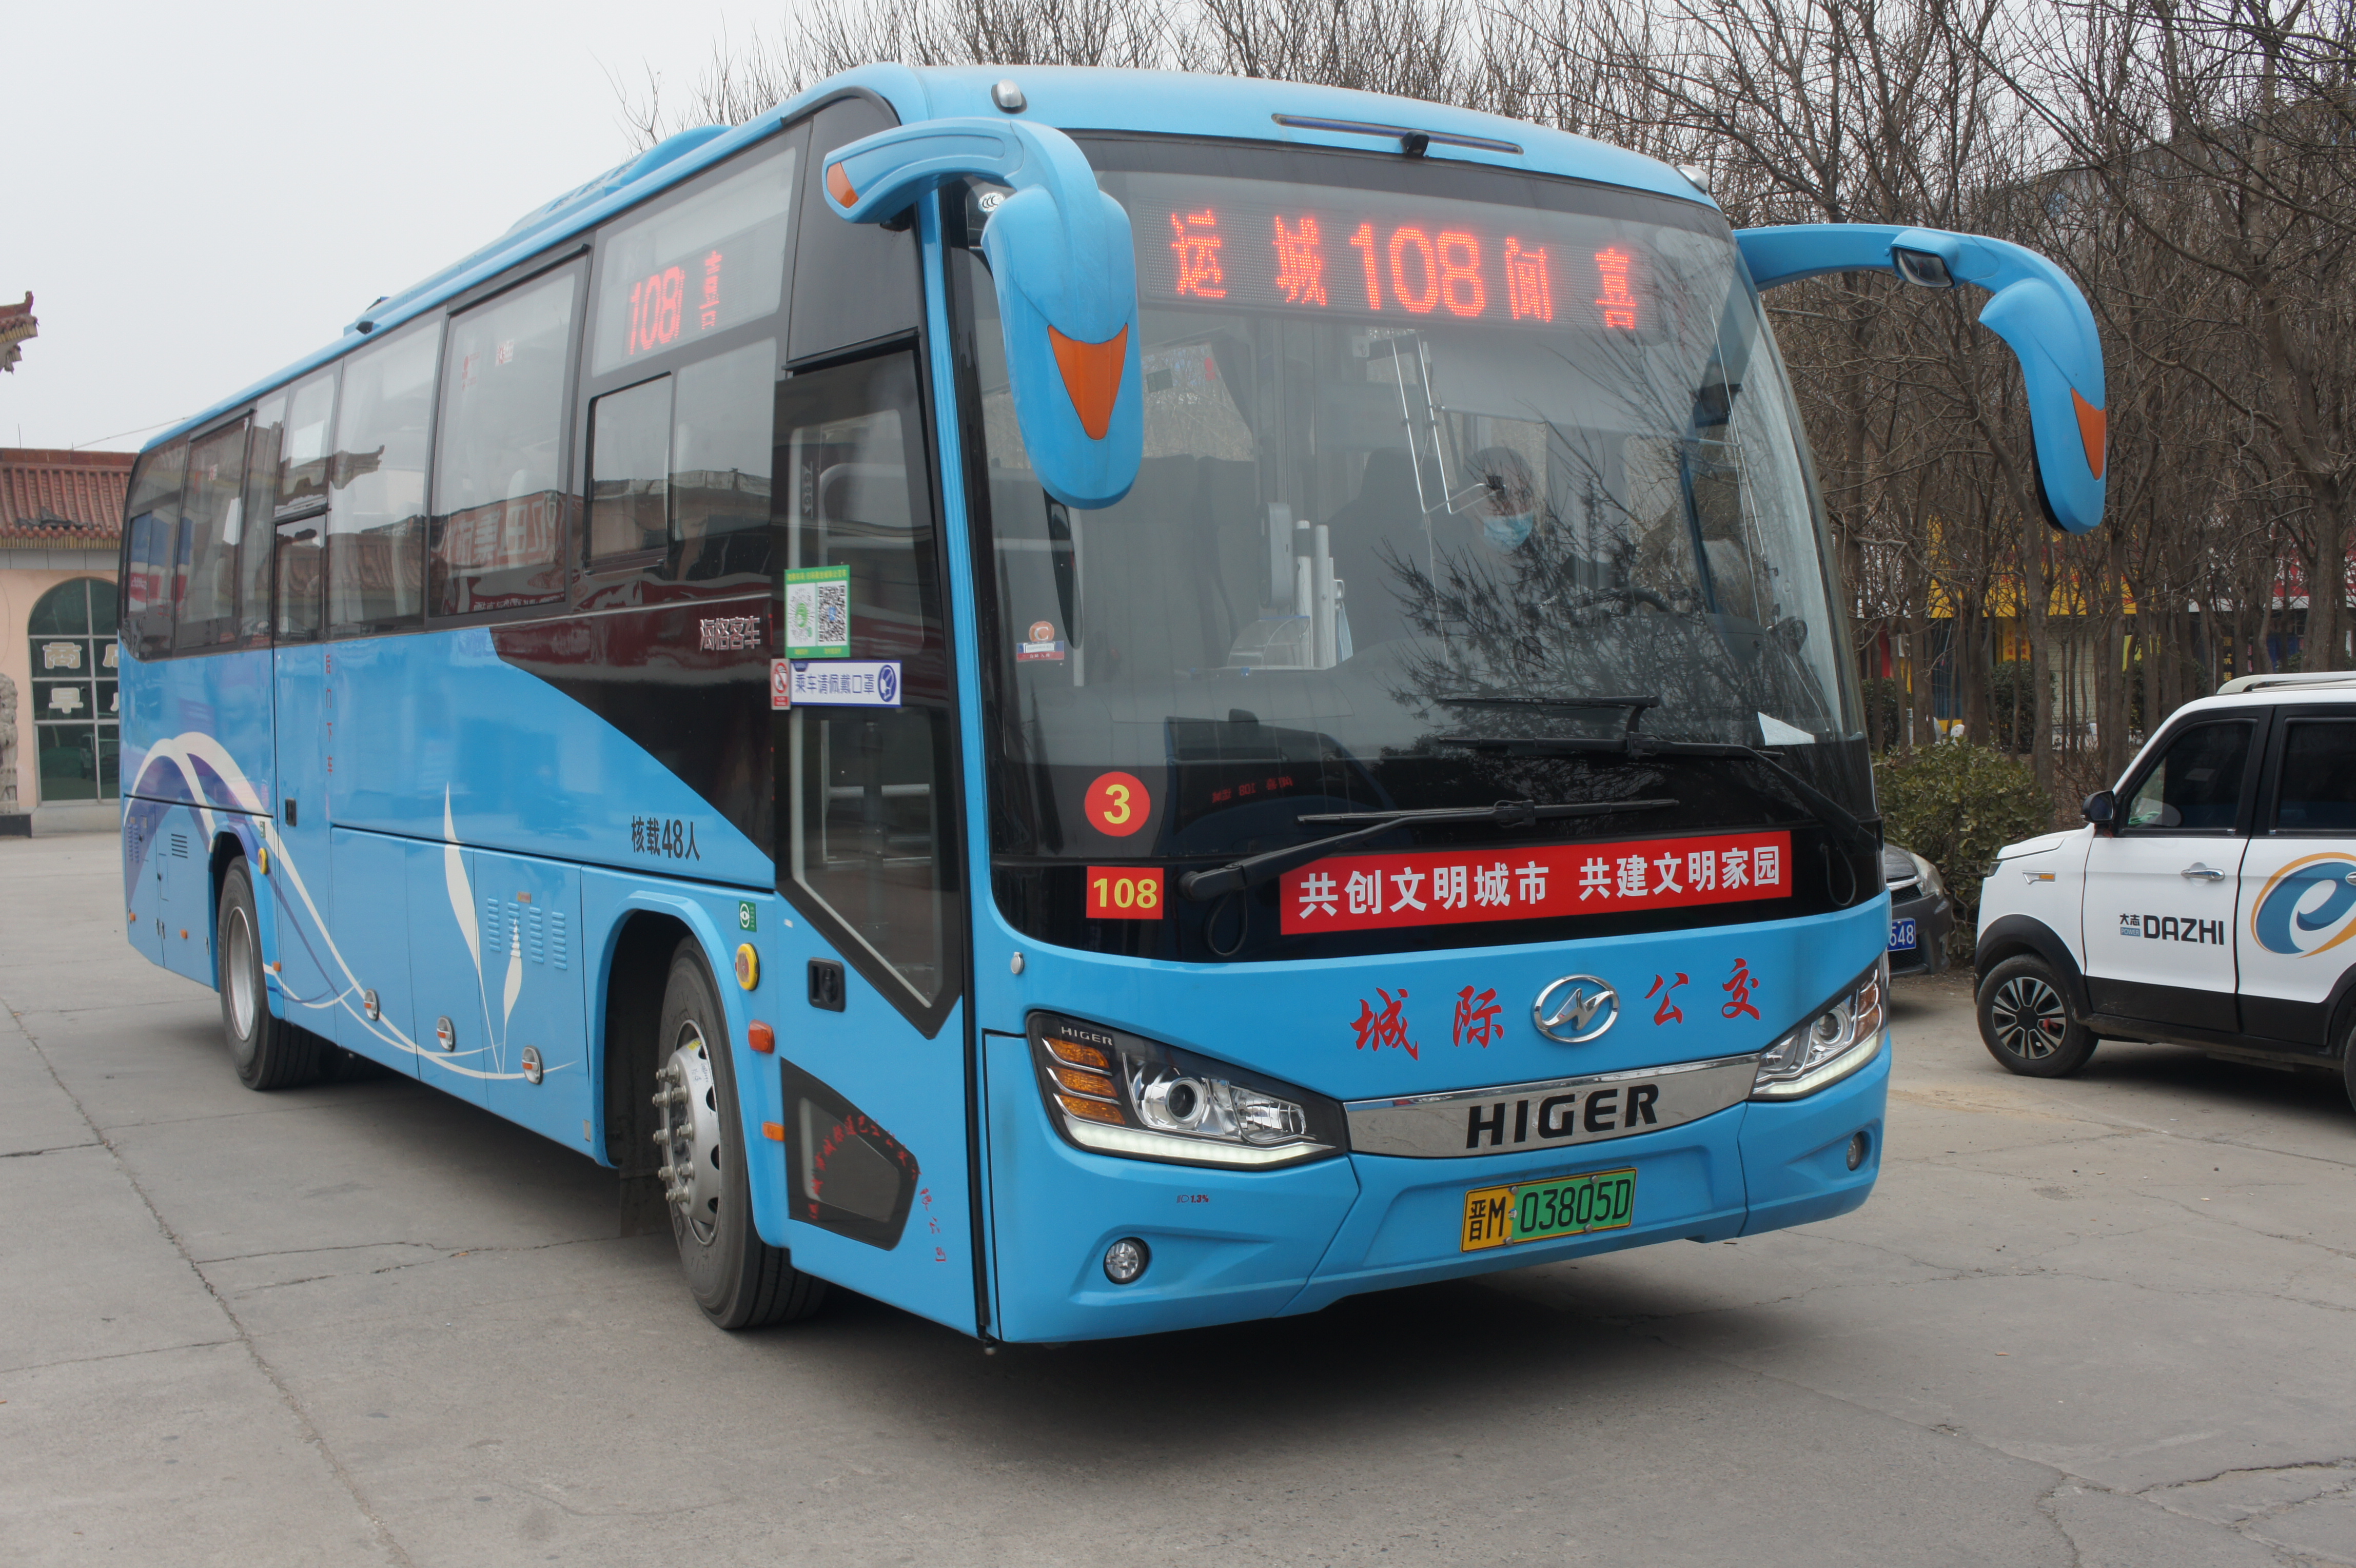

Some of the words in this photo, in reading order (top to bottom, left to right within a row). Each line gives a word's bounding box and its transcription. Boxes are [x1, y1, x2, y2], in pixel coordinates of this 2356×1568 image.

[1170, 208, 1328, 307] 运城
[1350, 223, 1486, 318] 108
[1505, 236, 1636, 330] 闻喜
[627, 265, 684, 355] 108
[699, 615, 760, 652] 海格客车
[795, 673, 875, 695] 乘车请佩戴口罩
[1104, 784, 1131, 824] 3
[631, 815, 700, 862] 核载48人
[1093, 878, 1157, 910] 108
[1298, 860, 1550, 919] 共创文明城市
[1578, 845, 1781, 901] 共建文明家园
[2119, 913, 2140, 926] 大志
[2121, 928, 2139, 936] POWER
[2144, 914, 2224, 945] DAZHI
[1350, 984, 1504, 1061] 城际
[1644, 957, 1761, 1026] 公交
[1061, 1026, 1113, 1046] HIGER
[1465, 1083, 1659, 1149] HIGER
[1190, 1194, 1210, 1203] 1.3%
[1468, 1195, 1506, 1242] 晋M
[1519, 1178, 1632, 1233] 03805D
